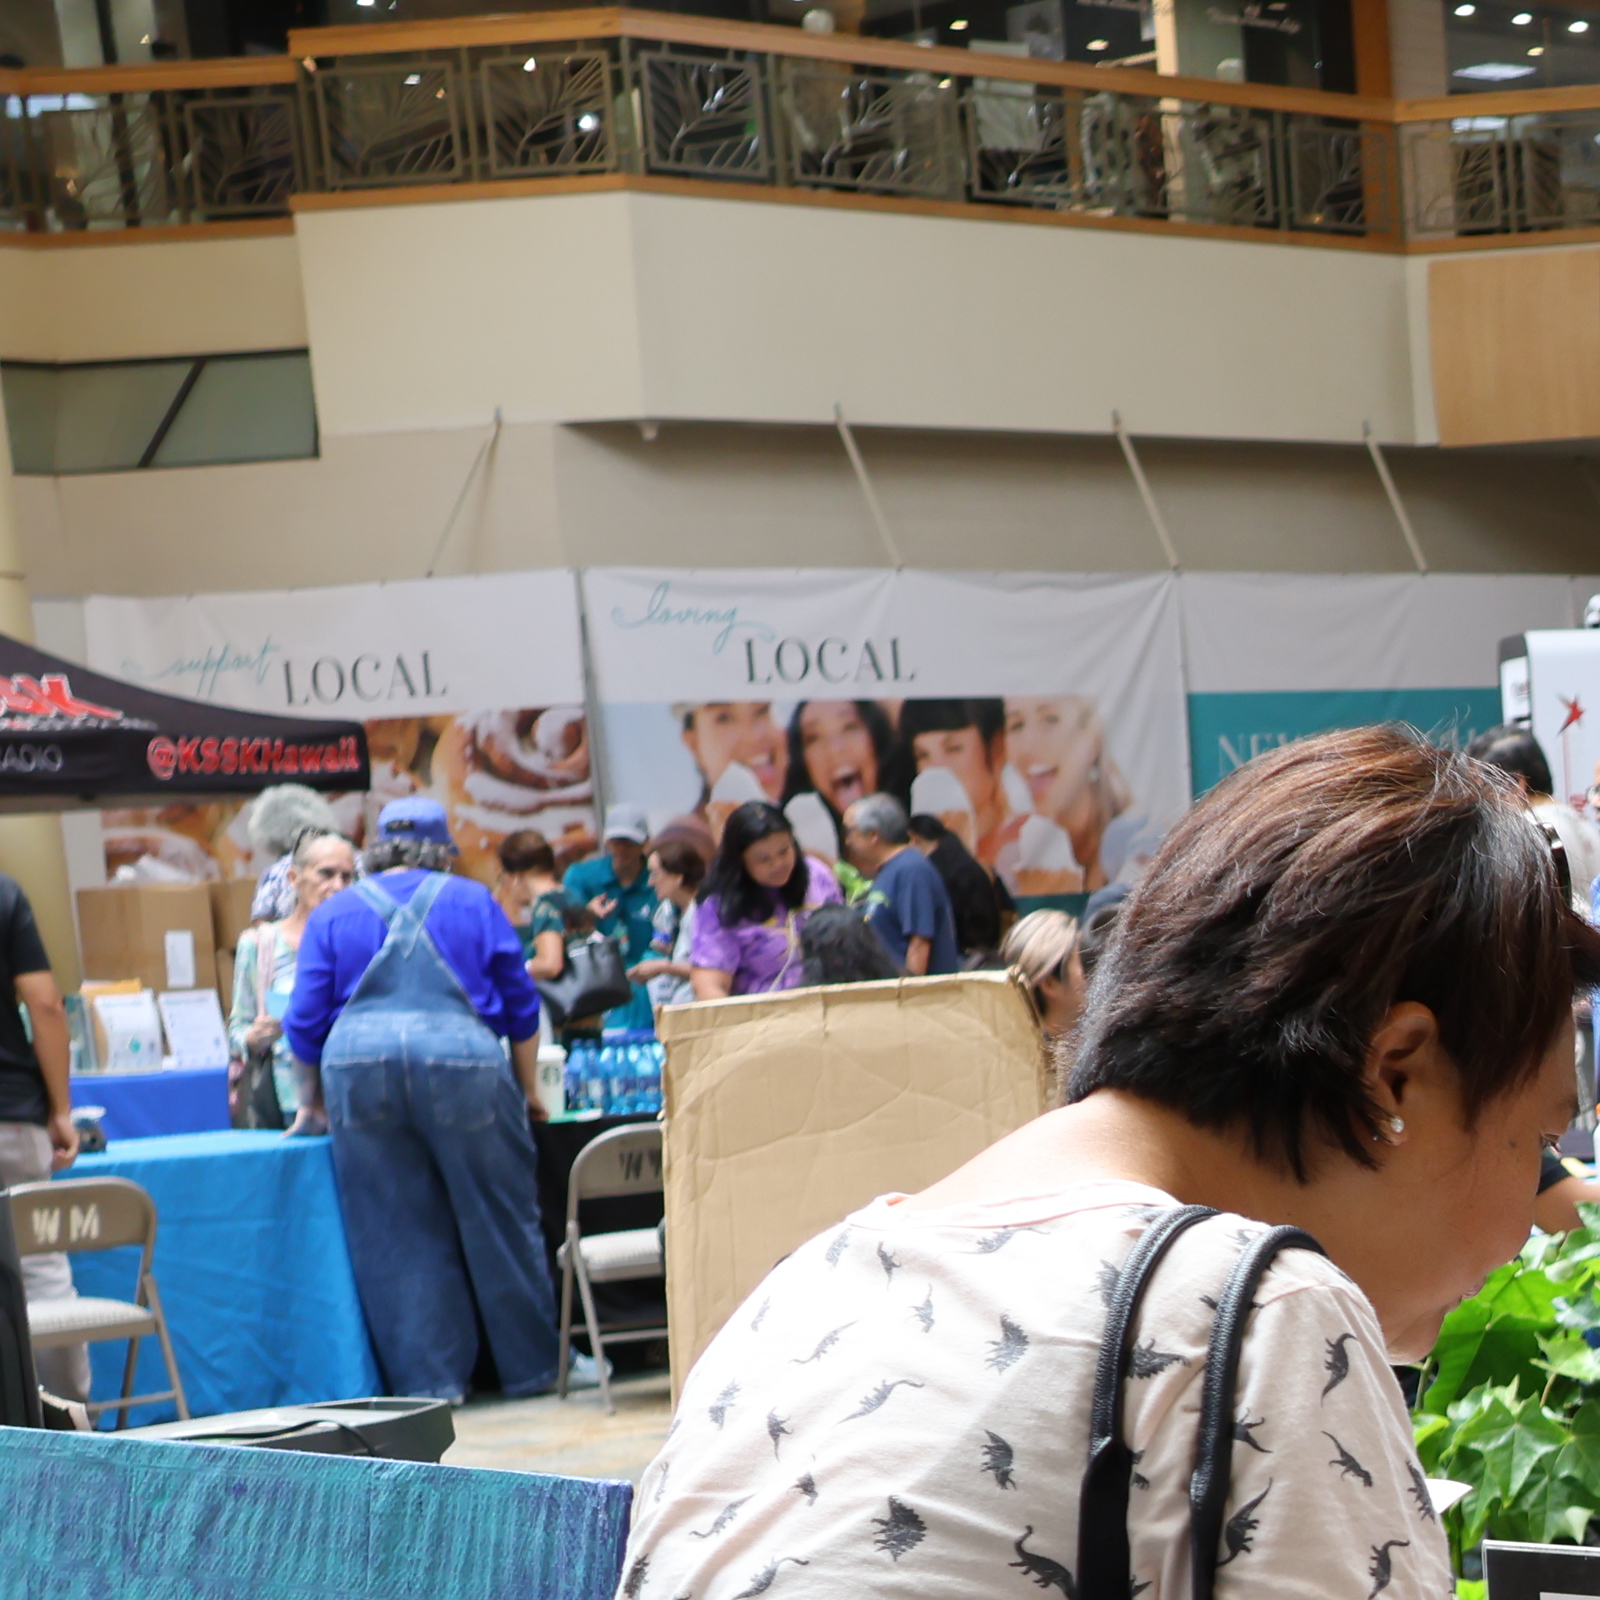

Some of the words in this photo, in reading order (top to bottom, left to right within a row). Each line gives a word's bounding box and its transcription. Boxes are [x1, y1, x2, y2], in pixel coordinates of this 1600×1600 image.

[615, 582, 762, 654] loving
[140, 634, 280, 698] support
[282, 650, 447, 706] LOCAL
[744, 636, 915, 686] LOCAL
